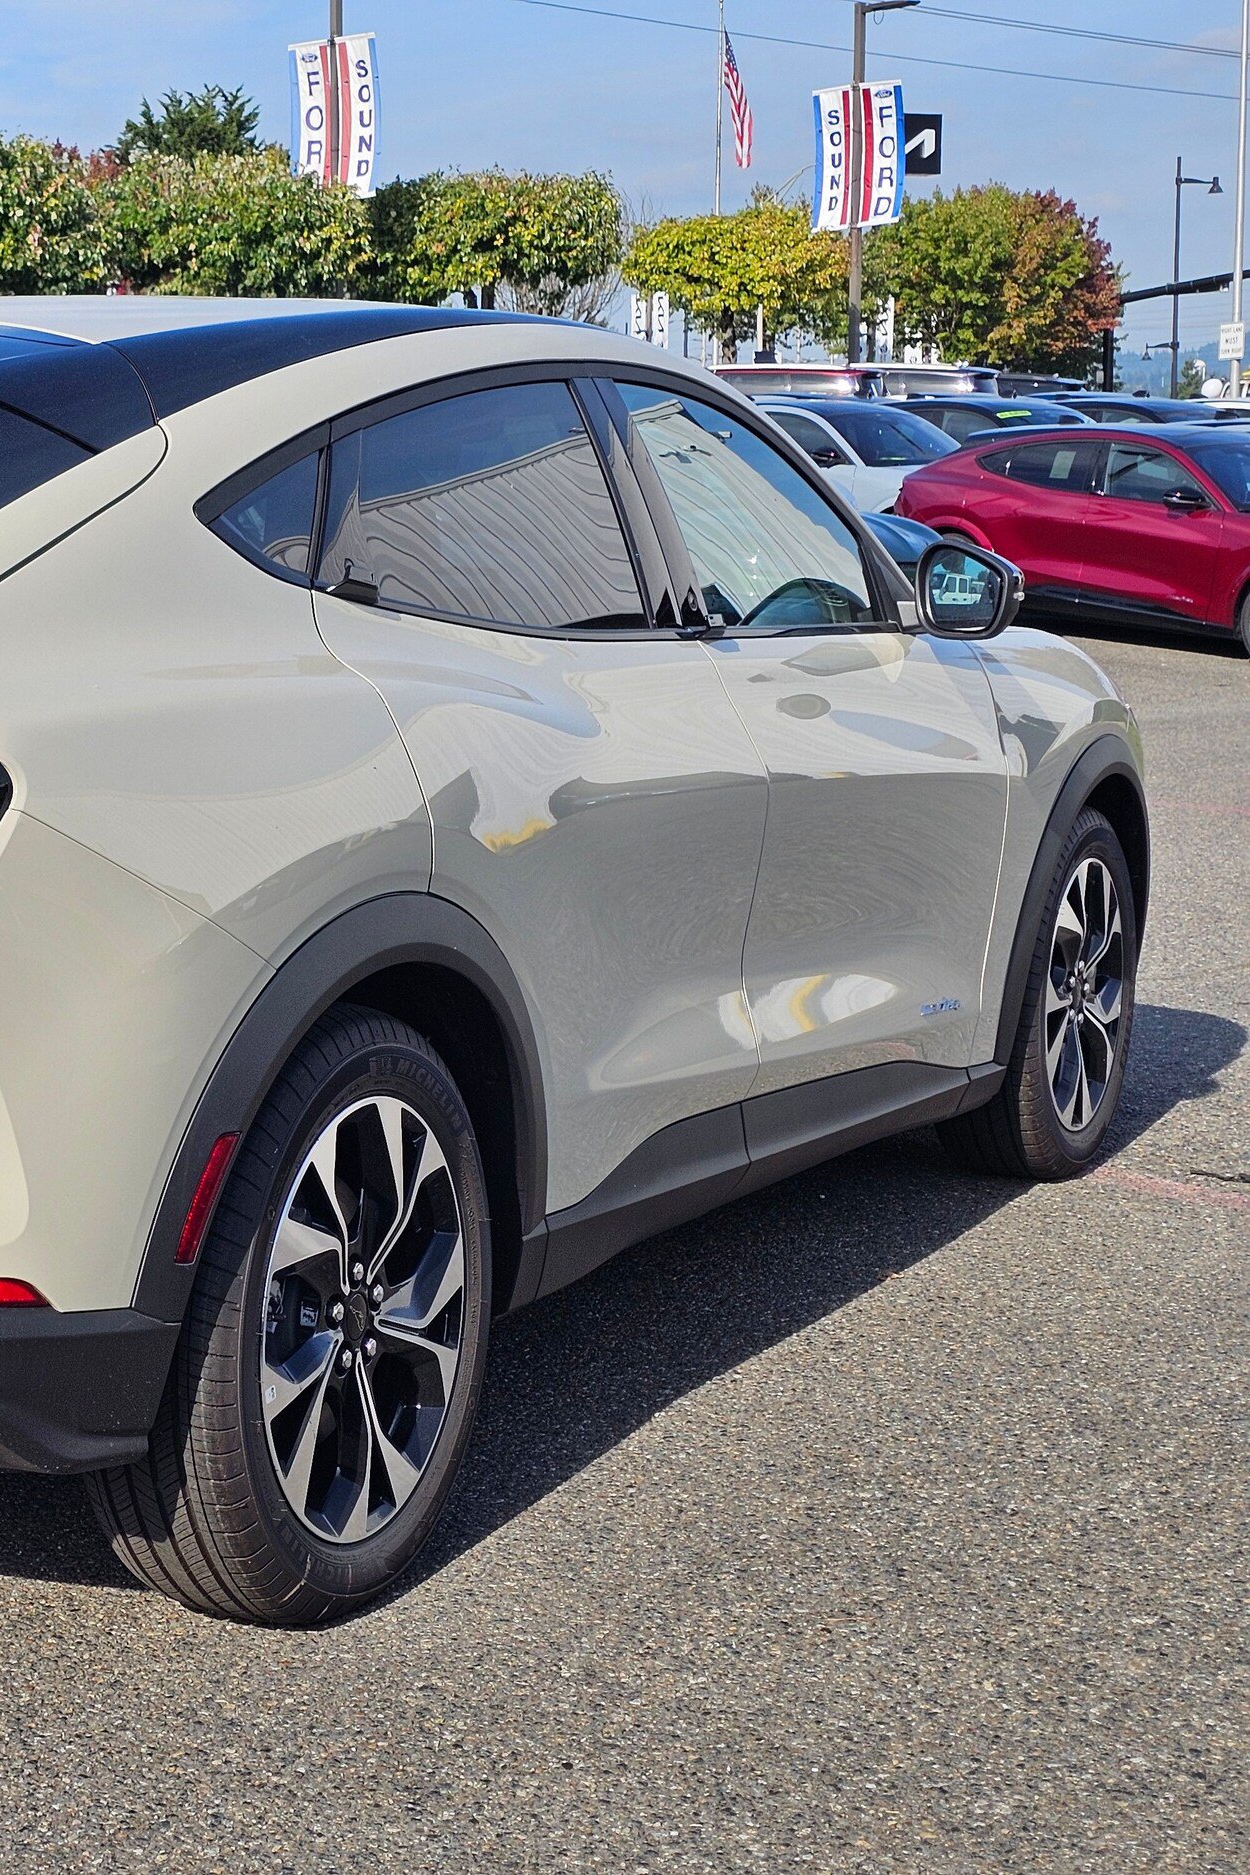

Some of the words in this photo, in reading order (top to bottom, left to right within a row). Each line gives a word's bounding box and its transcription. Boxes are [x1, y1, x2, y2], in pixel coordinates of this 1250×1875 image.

[305, 71, 324, 167] FOR
[355, 59, 373, 178] SOUND
[827, 109, 842, 212] SOUND
[873, 105, 895, 217] FORD
[1225, 336, 1238, 345] MUST
[395, 1058, 463, 1130] MICHELIN
